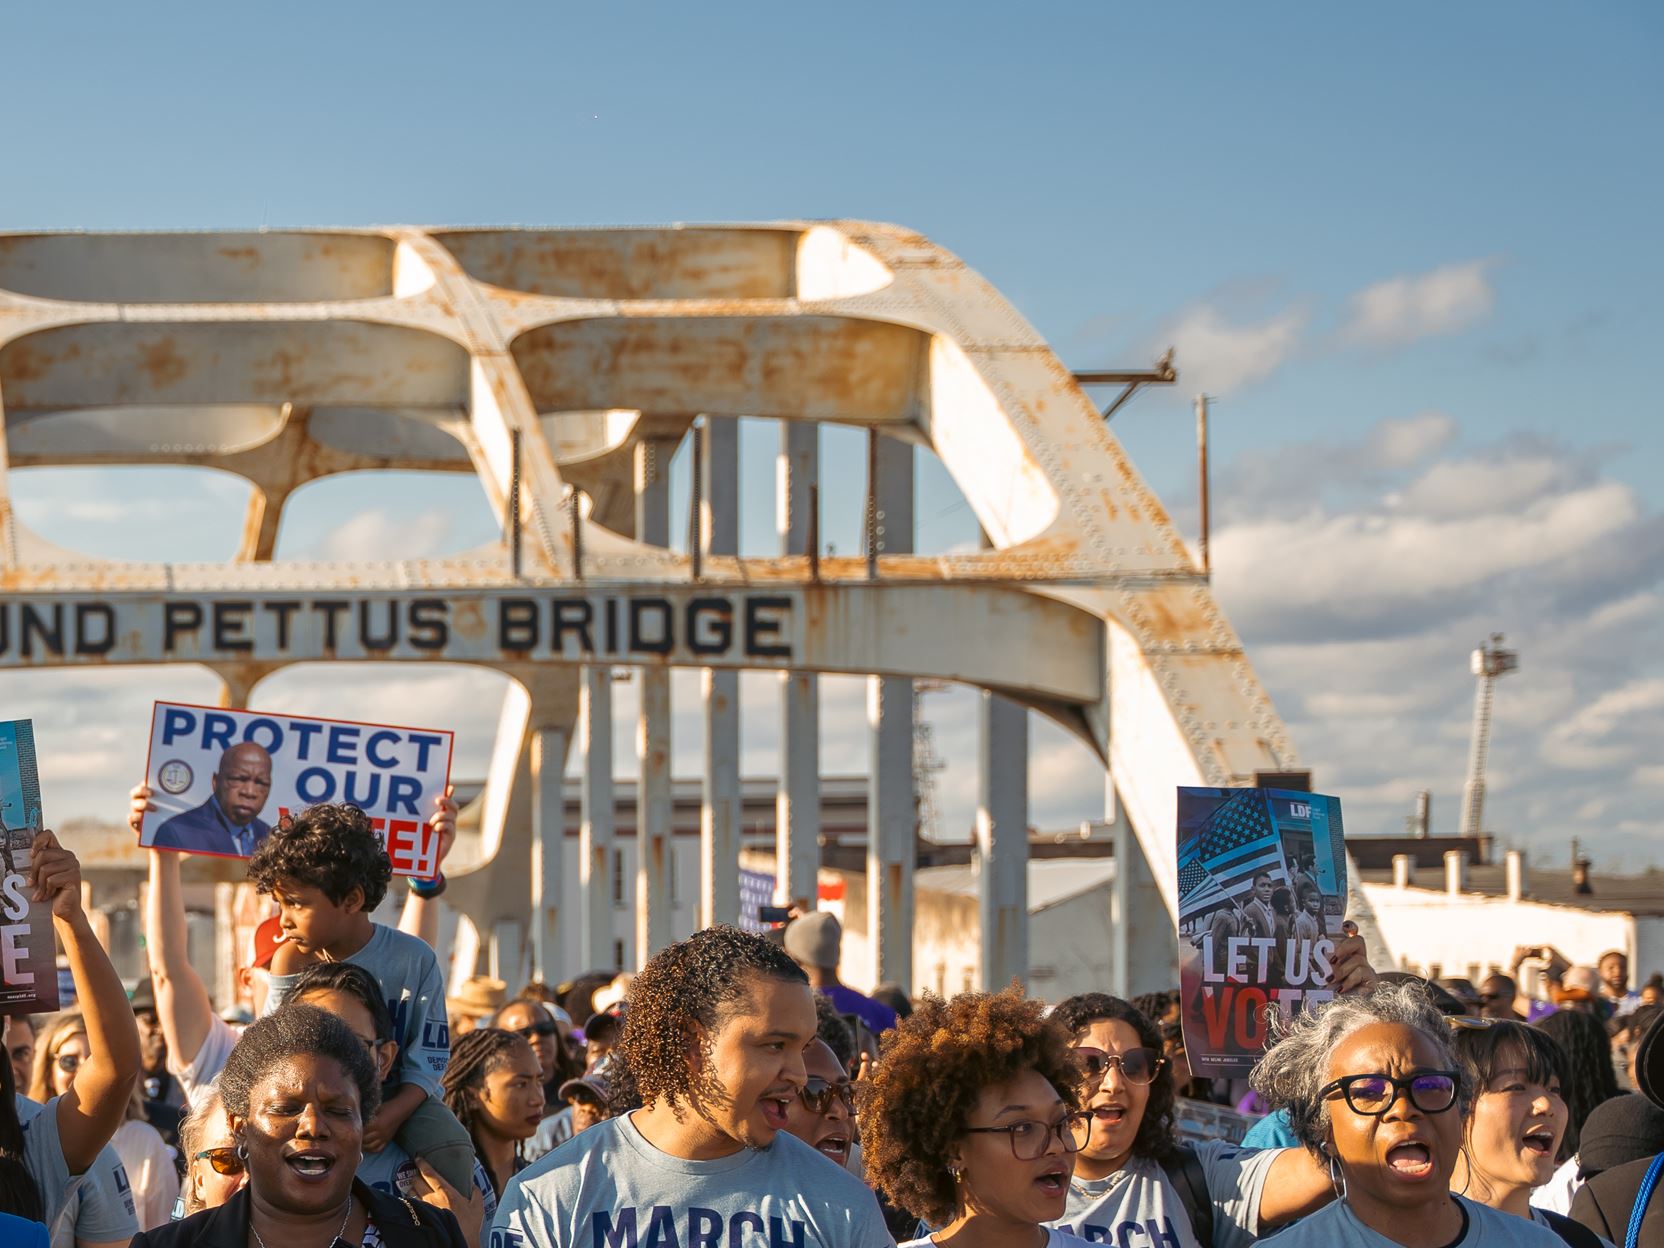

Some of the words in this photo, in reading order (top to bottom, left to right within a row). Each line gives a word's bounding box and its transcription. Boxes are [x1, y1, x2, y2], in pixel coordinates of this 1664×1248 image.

[162, 598, 450, 657] PETTUS
[496, 596, 794, 659] BRIDGE
[162, 708, 442, 773] PROTECT
[295, 766, 423, 816] OUR
[1290, 804, 1312, 818] LDF
[1203, 936, 1276, 984] LET
[1285, 939, 1335, 986] US
[422, 1022, 450, 1049] LD
